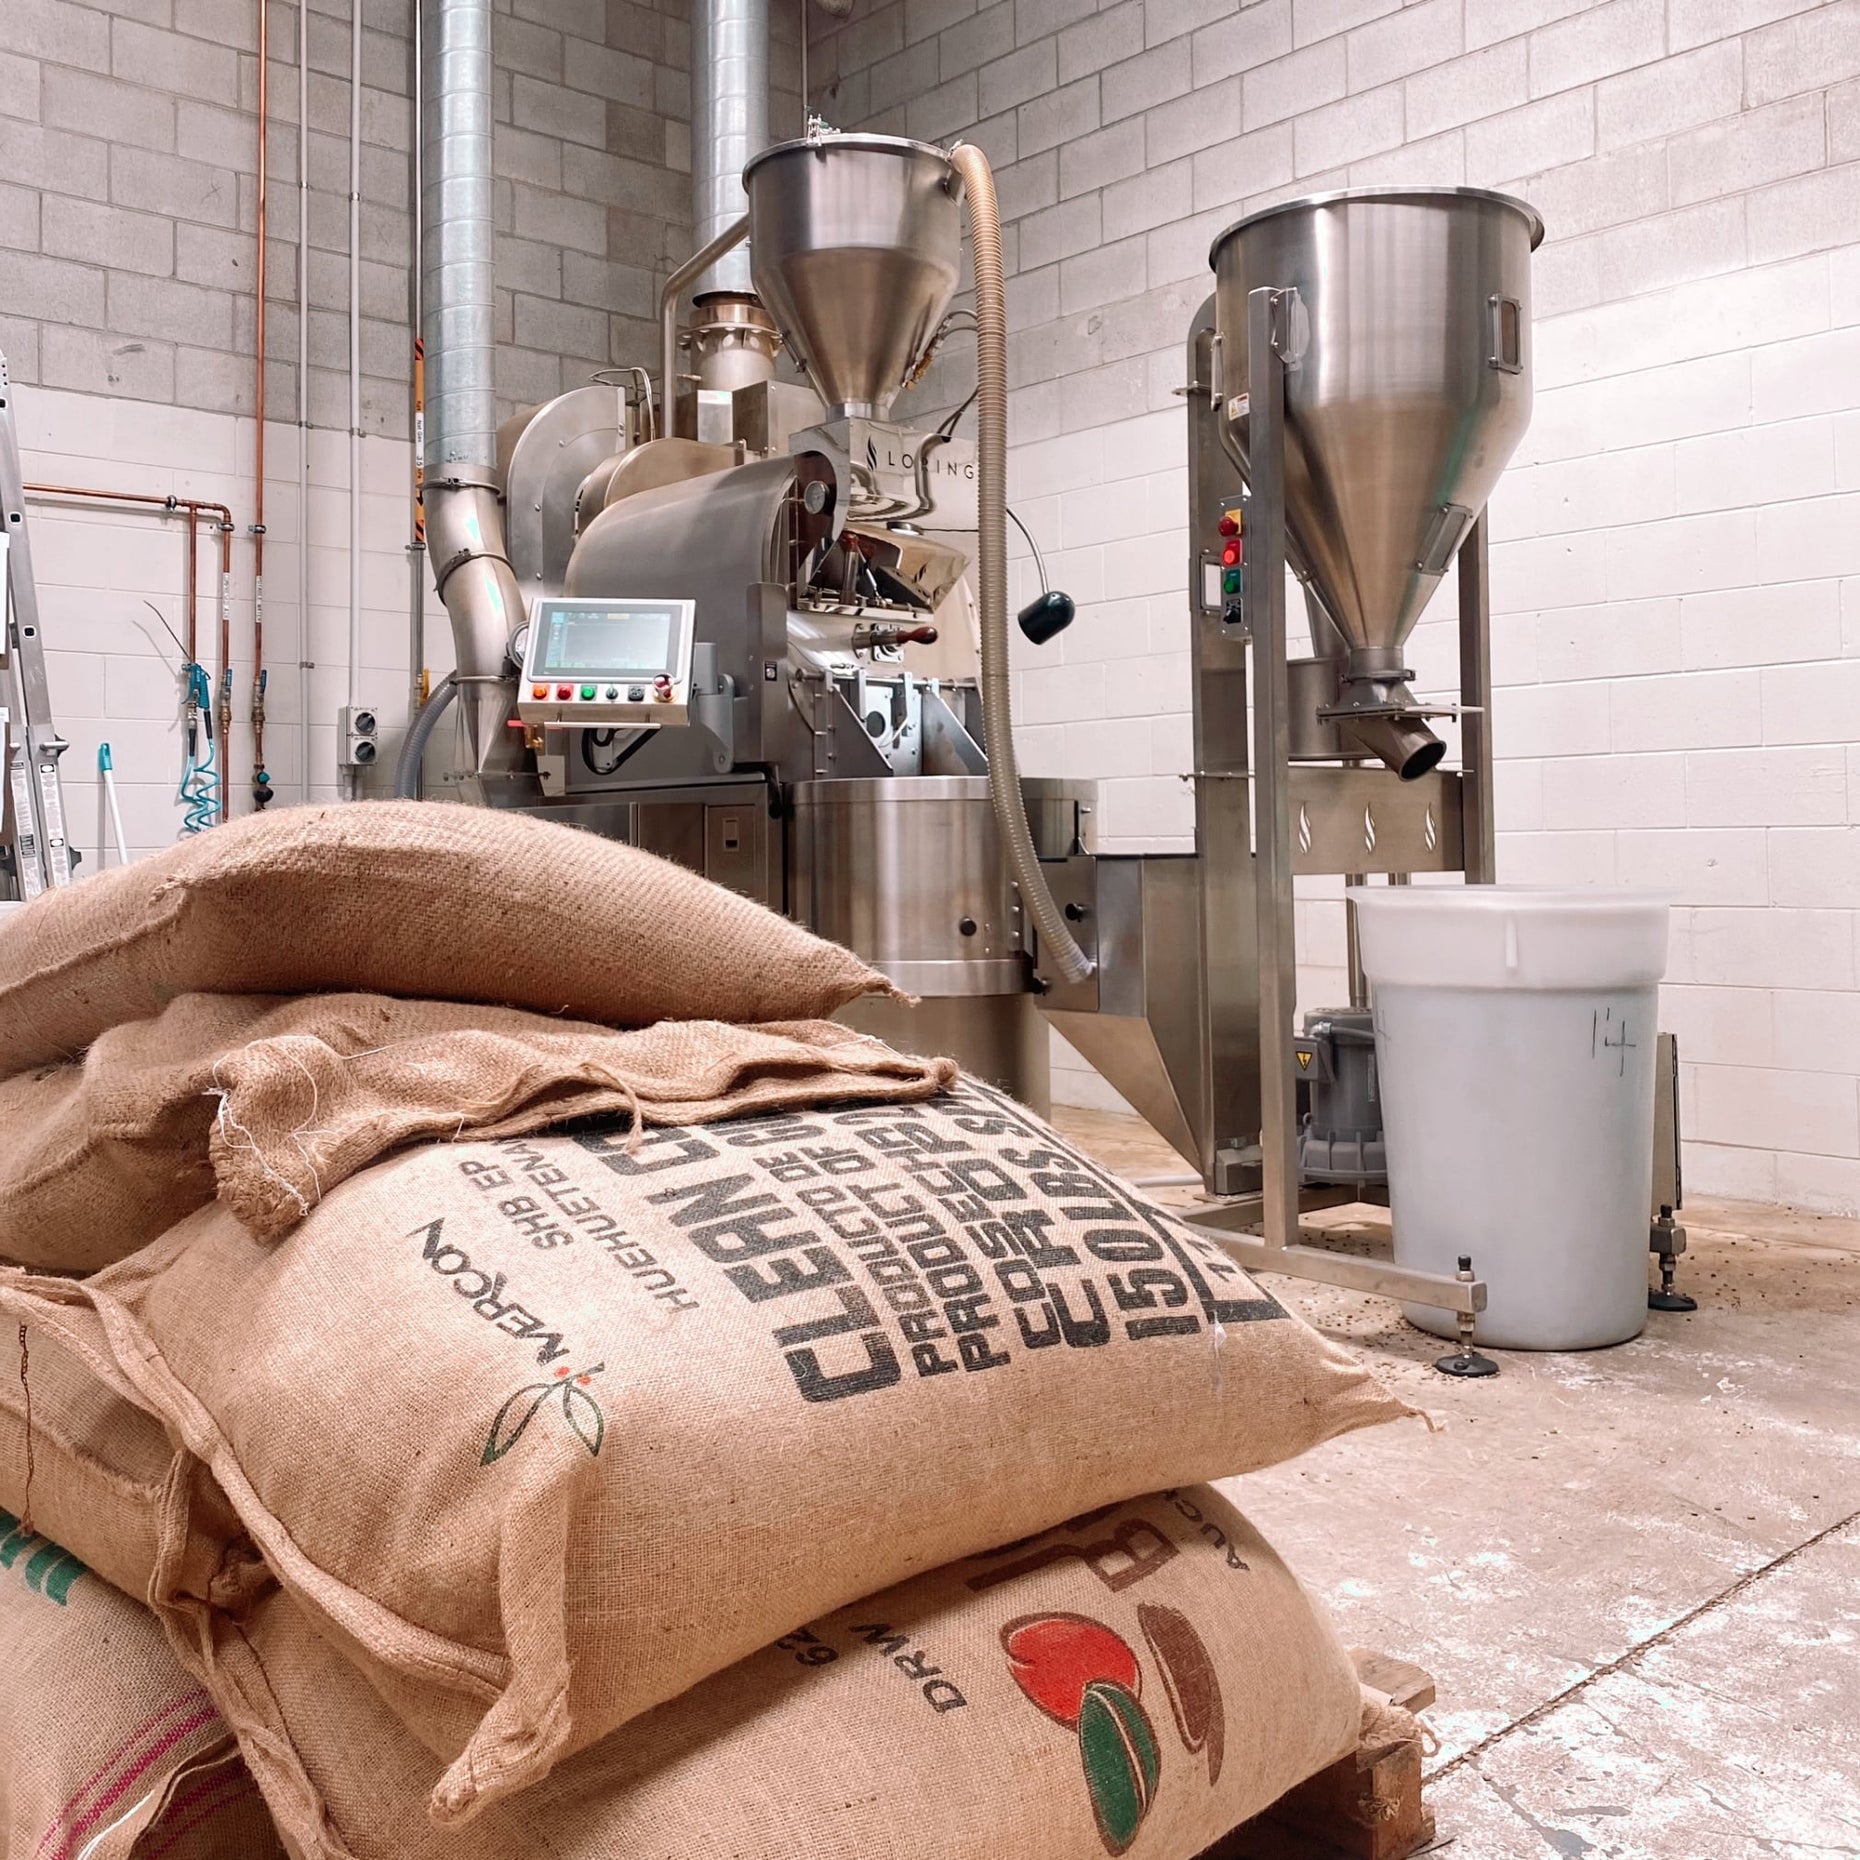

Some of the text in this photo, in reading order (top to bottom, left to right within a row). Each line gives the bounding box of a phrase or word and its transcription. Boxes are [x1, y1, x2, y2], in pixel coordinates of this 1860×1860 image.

[888, 450, 975, 480] LORING
[458, 1160, 574, 1250] SHB EP
[853, 1126, 1063, 1349] COSECHA
[998, 1142, 1139, 1221] LBS.
[405, 1217, 570, 1367] MERCON
[644, 1172, 901, 1403] CLEAN
[752, 1151, 959, 1378] PRODUCTO DE
[797, 1146, 1012, 1374] PRODUCT OF
[1084, 1229, 1201, 1340] 150
[848, 1623, 968, 1716] DRW
